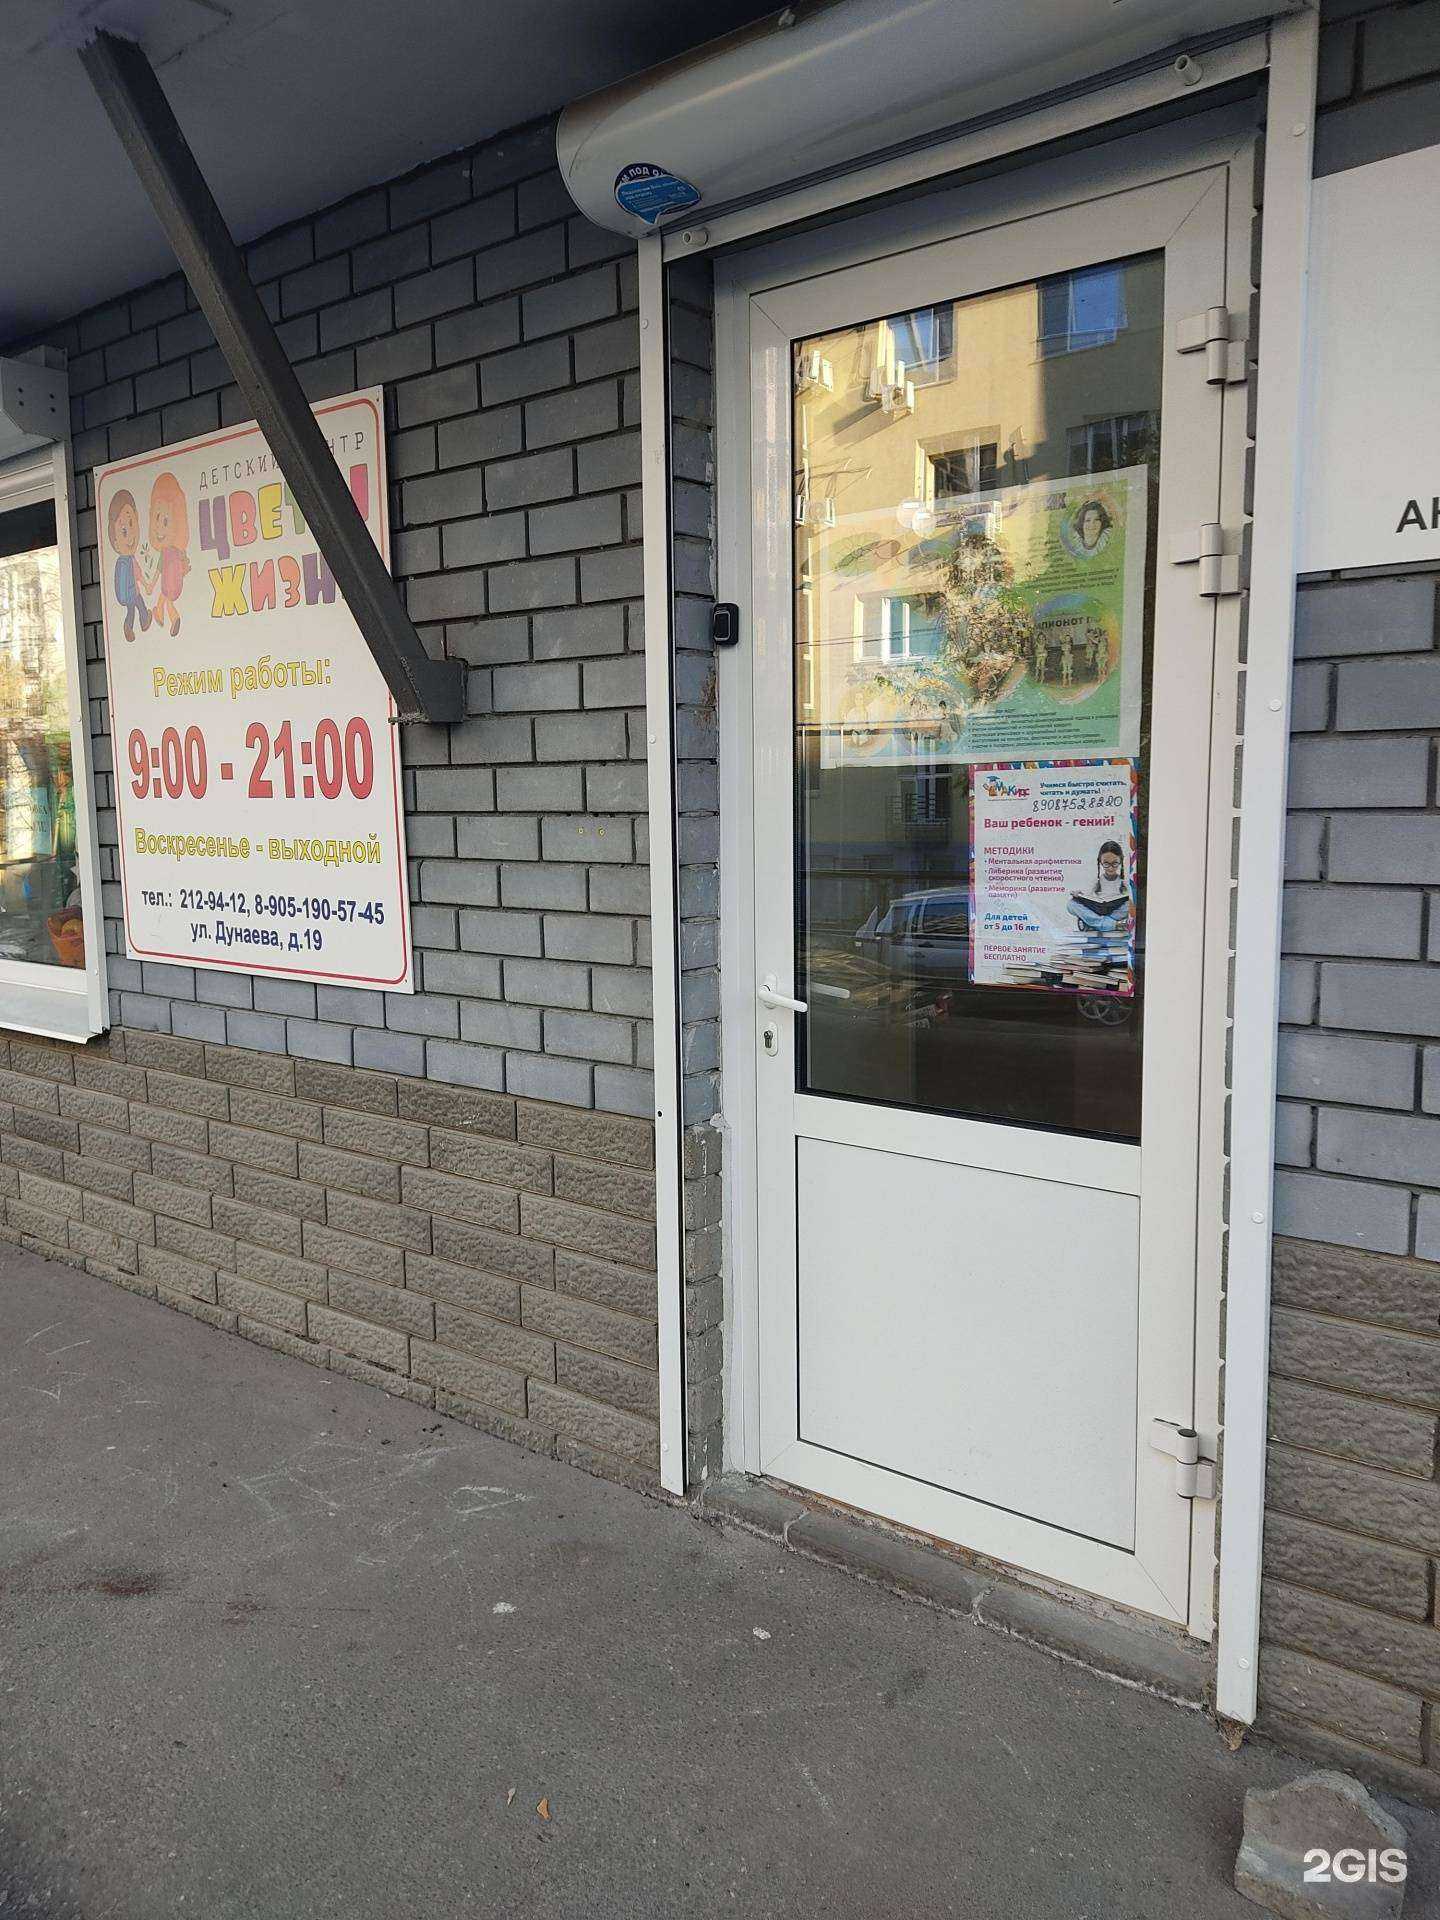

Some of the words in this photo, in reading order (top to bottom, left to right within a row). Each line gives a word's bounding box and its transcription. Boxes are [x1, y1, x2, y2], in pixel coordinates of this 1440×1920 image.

[208, 551, 346, 618] ЖИЗН
[152, 666, 223, 697] Режим
[230, 655, 331, 699] работы:
[128, 725, 208, 799] 9:00
[245, 717, 374, 799] 21:00
[1068, 780, 1095, 788] быстро
[984, 818, 1008, 828] Ваш
[1011, 818, 1063, 830] ребенок
[1073, 816, 1115, 827] гений!
[135, 828, 250, 861] Воскресенье
[268, 833, 381, 867] выходной
[984, 847, 1034, 855] МЕТОДИКИ
[1034, 858, 1082, 866] арифметика
[141, 889, 172, 907] тел.:
[180, 888, 251, 917] 212-94-12,
[254, 894, 385, 924] 8-905-190-57-45
[984, 913, 1000, 921] Для
[1002, 913, 1028, 921] детей
[1001, 924, 1013, 932] до
[1015, 923, 1024, 931] 16
[190, 922, 212, 943] ул.
[215, 921, 283, 949] Дунаева,
[288, 929, 323, 952] д.19
[984, 944, 1012, 953] ПЕРВОЕ
[1013, 946, 1046, 954] ЗАНЯТИЕ
[984, 954, 1027, 962] БЕСПЛАТНО
